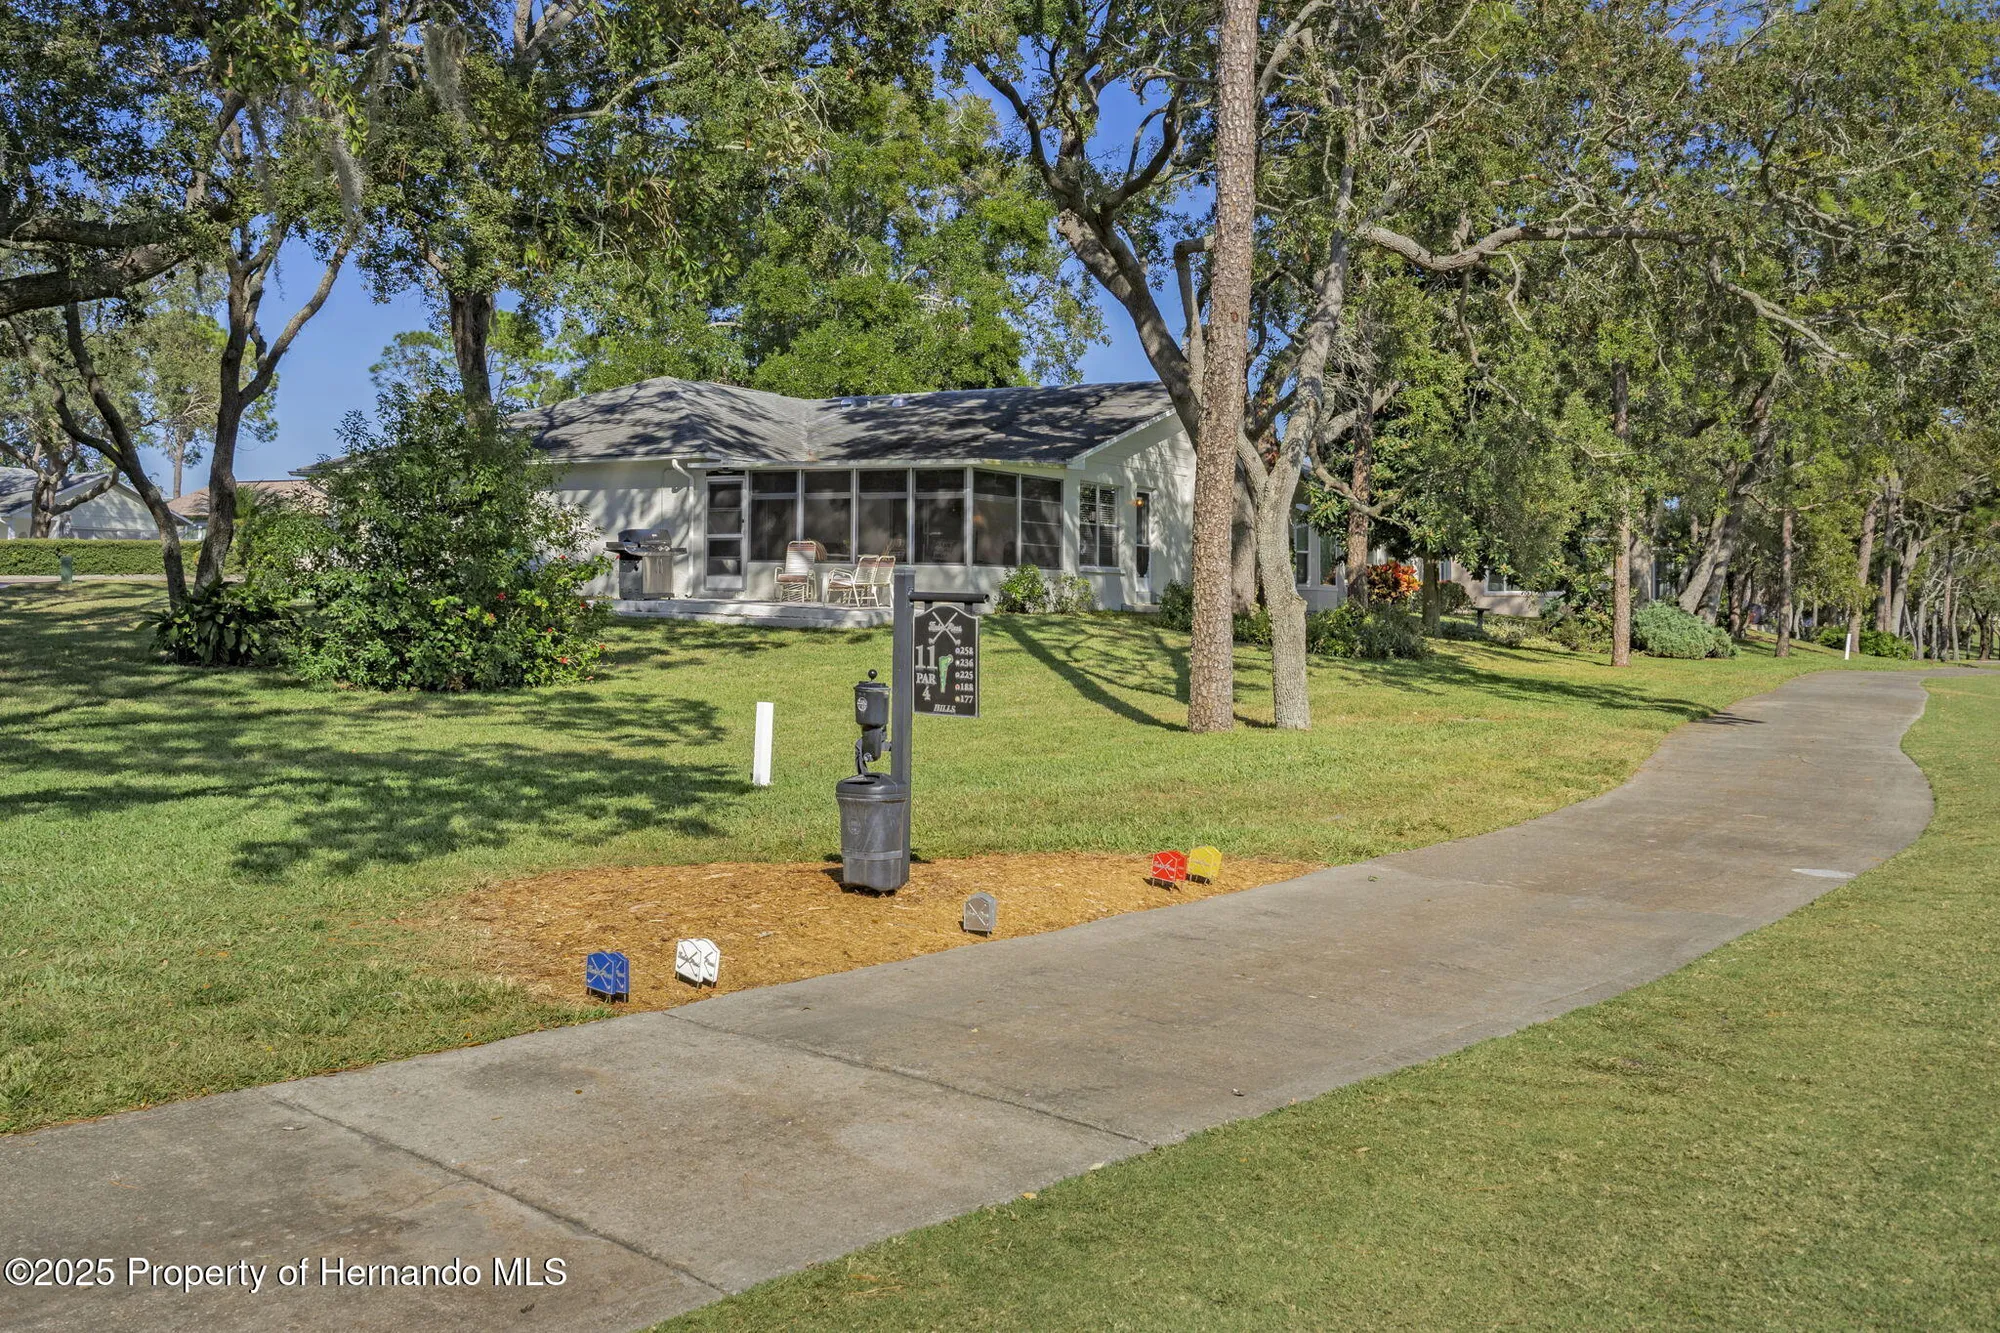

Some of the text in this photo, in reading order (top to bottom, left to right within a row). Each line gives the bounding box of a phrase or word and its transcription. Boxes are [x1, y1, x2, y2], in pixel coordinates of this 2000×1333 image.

[960, 646, 974, 656] 258
[915, 644, 938, 669] 11
[960, 658, 974, 667] 236
[915, 672, 937, 685] PAR
[960, 671, 974, 680] 225
[921, 685, 931, 701] 4
[960, 694, 974, 703] 177
